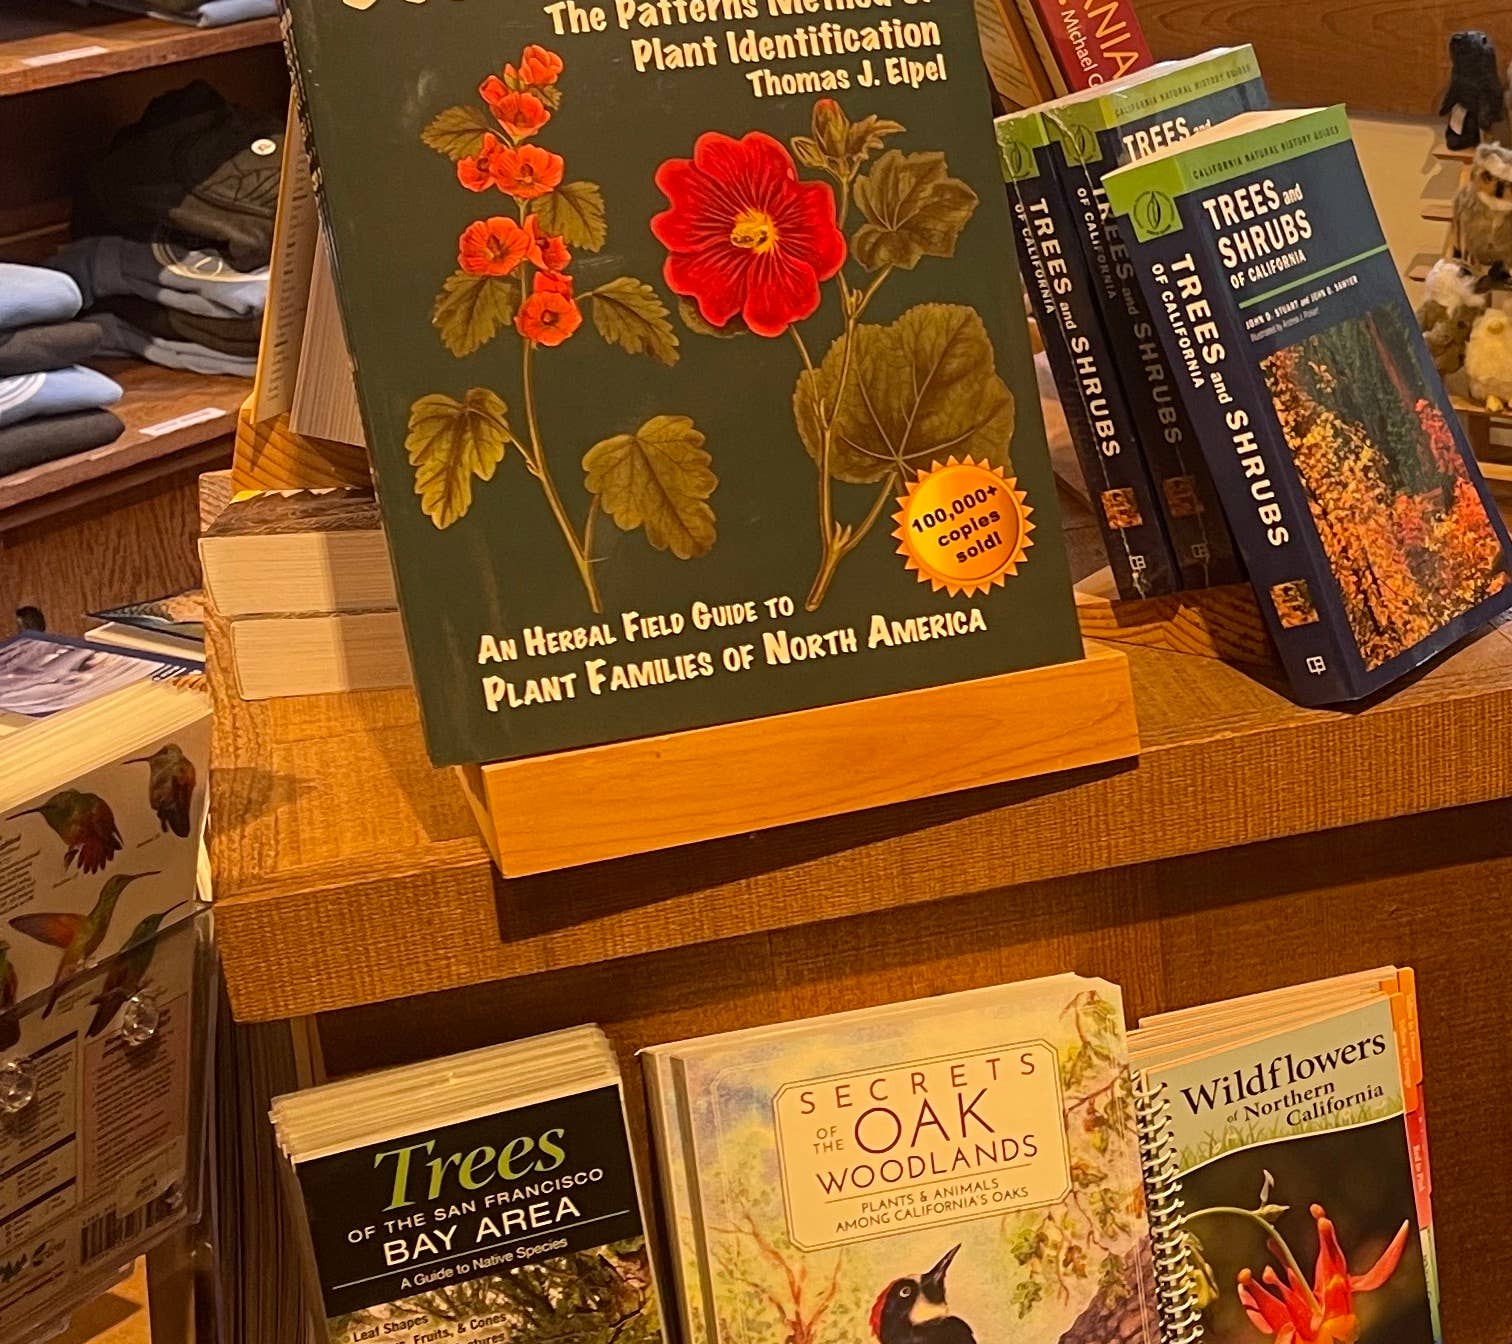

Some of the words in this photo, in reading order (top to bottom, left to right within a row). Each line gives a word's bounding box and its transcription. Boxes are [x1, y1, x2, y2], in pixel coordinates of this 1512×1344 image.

[633, 30, 719, 74] Plant
[726, 17, 941, 66] Identification
[1060, 9, 1098, 72] Michael
[747, 62, 850, 101] Thomas
[856, 60, 880, 90] J.
[886, 54, 947, 93] Elpel
[1192, 154, 1243, 180] CALIFORNIA
[1280, 135, 1312, 154] HISTORY
[1202, 179, 1281, 231] TREES
[1282, 183, 1303, 206] and
[1218, 209, 1313, 269] SHRUBS
[1230, 272, 1245, 290] OF
[1249, 248, 1307, 282] CALIFORNIA
[911, 484, 999, 535] 100,000+
[937, 508, 1002, 549] copies
[955, 531, 1003, 565] sold!
[523, 622, 617, 656] HERBAL
[621, 610, 685, 642] FIELD
[691, 599, 759, 630] GUIDE
[763, 595, 795, 619] TO
[482, 671, 577, 713] PLANT
[585, 649, 714, 696] FAMILIES
[722, 644, 754, 671] OF
[762, 622, 859, 666] NORTH
[866, 608, 988, 650] AMERICA
[800, 1053, 1036, 1115] SECRETS
[1180, 1033, 1386, 1115] Wildflowers
[855, 1088, 996, 1154] OAK
[1226, 1111, 1238, 1123] of
[1245, 1081, 1336, 1121] Northern
[1286, 1084, 1384, 1126] California
[813, 1139, 845, 1154] THE
[816, 1125, 838, 1140] OF
[373, 1128, 566, 1212] Trees
[816, 1134, 1038, 1194] WOODLANDS
[347, 1226, 377, 1244] OF
[383, 1213, 427, 1235] THE
[433, 1199, 477, 1221] SAN
[484, 1167, 604, 1208] FRANCISCO
[836, 1213, 890, 1232] AMONG
[894, 1191, 988, 1221] CALIFORNIA'S
[992, 1187, 1029, 1202] OAKS
[861, 1194, 914, 1214] PLANTS
[919, 1190, 929, 1202] &
[934, 1178, 1000, 1200] ANIMALS
[383, 1225, 458, 1266] BAY
[475, 1196, 581, 1243] AREA
[401, 1278, 412, 1290] A
[414, 1267, 454, 1287] Guide
[456, 1263, 470, 1275] to
[472, 1252, 514, 1270] Native
[515, 1237, 568, 1260] Species
[353, 1325, 380, 1342] Leaf
[383, 1314, 429, 1335] Shapes
[457, 1323, 466, 1334] &
[469, 1312, 507, 1330] Cones
